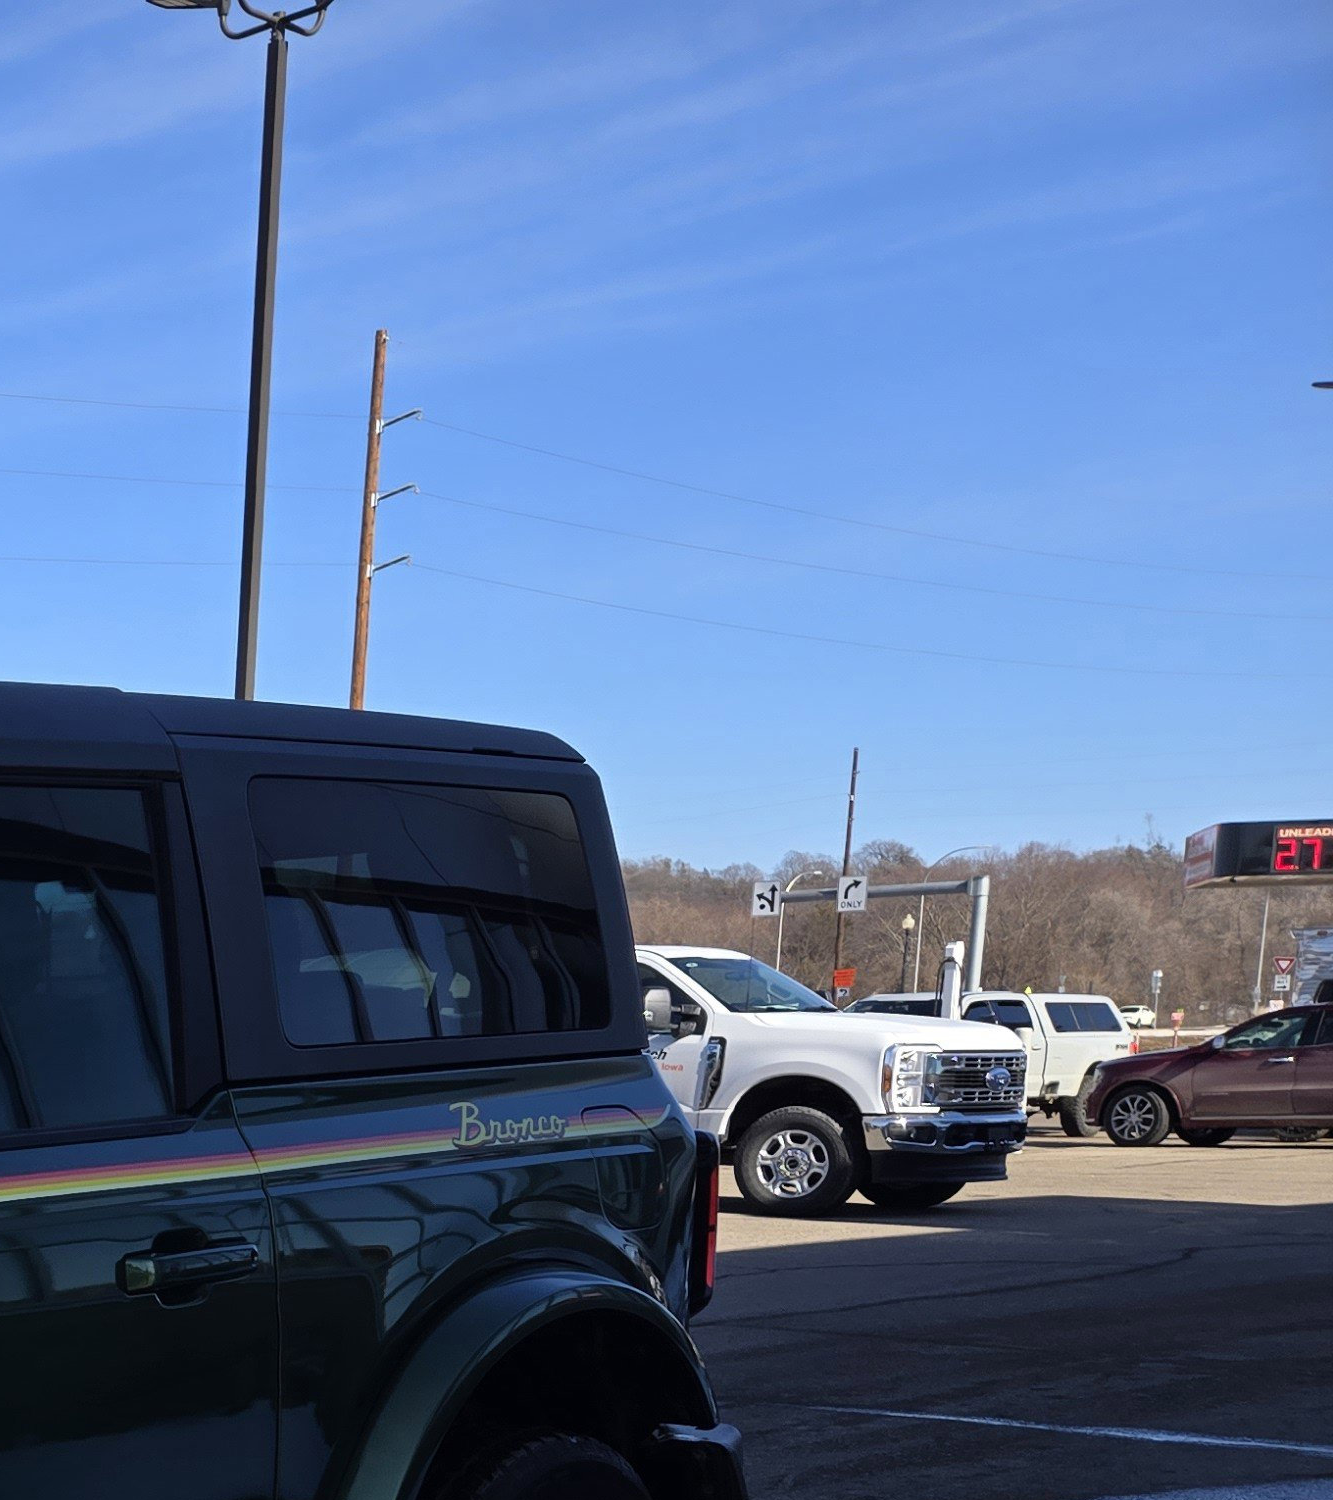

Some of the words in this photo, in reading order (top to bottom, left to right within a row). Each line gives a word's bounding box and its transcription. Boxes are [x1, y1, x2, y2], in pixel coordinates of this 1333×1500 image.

[1279, 827, 1333, 838] UNLEAD
[840, 901, 862, 909] ONLY
[661, 1063, 684, 1071] Iowa
[449, 1101, 566, 1148] Bronco
